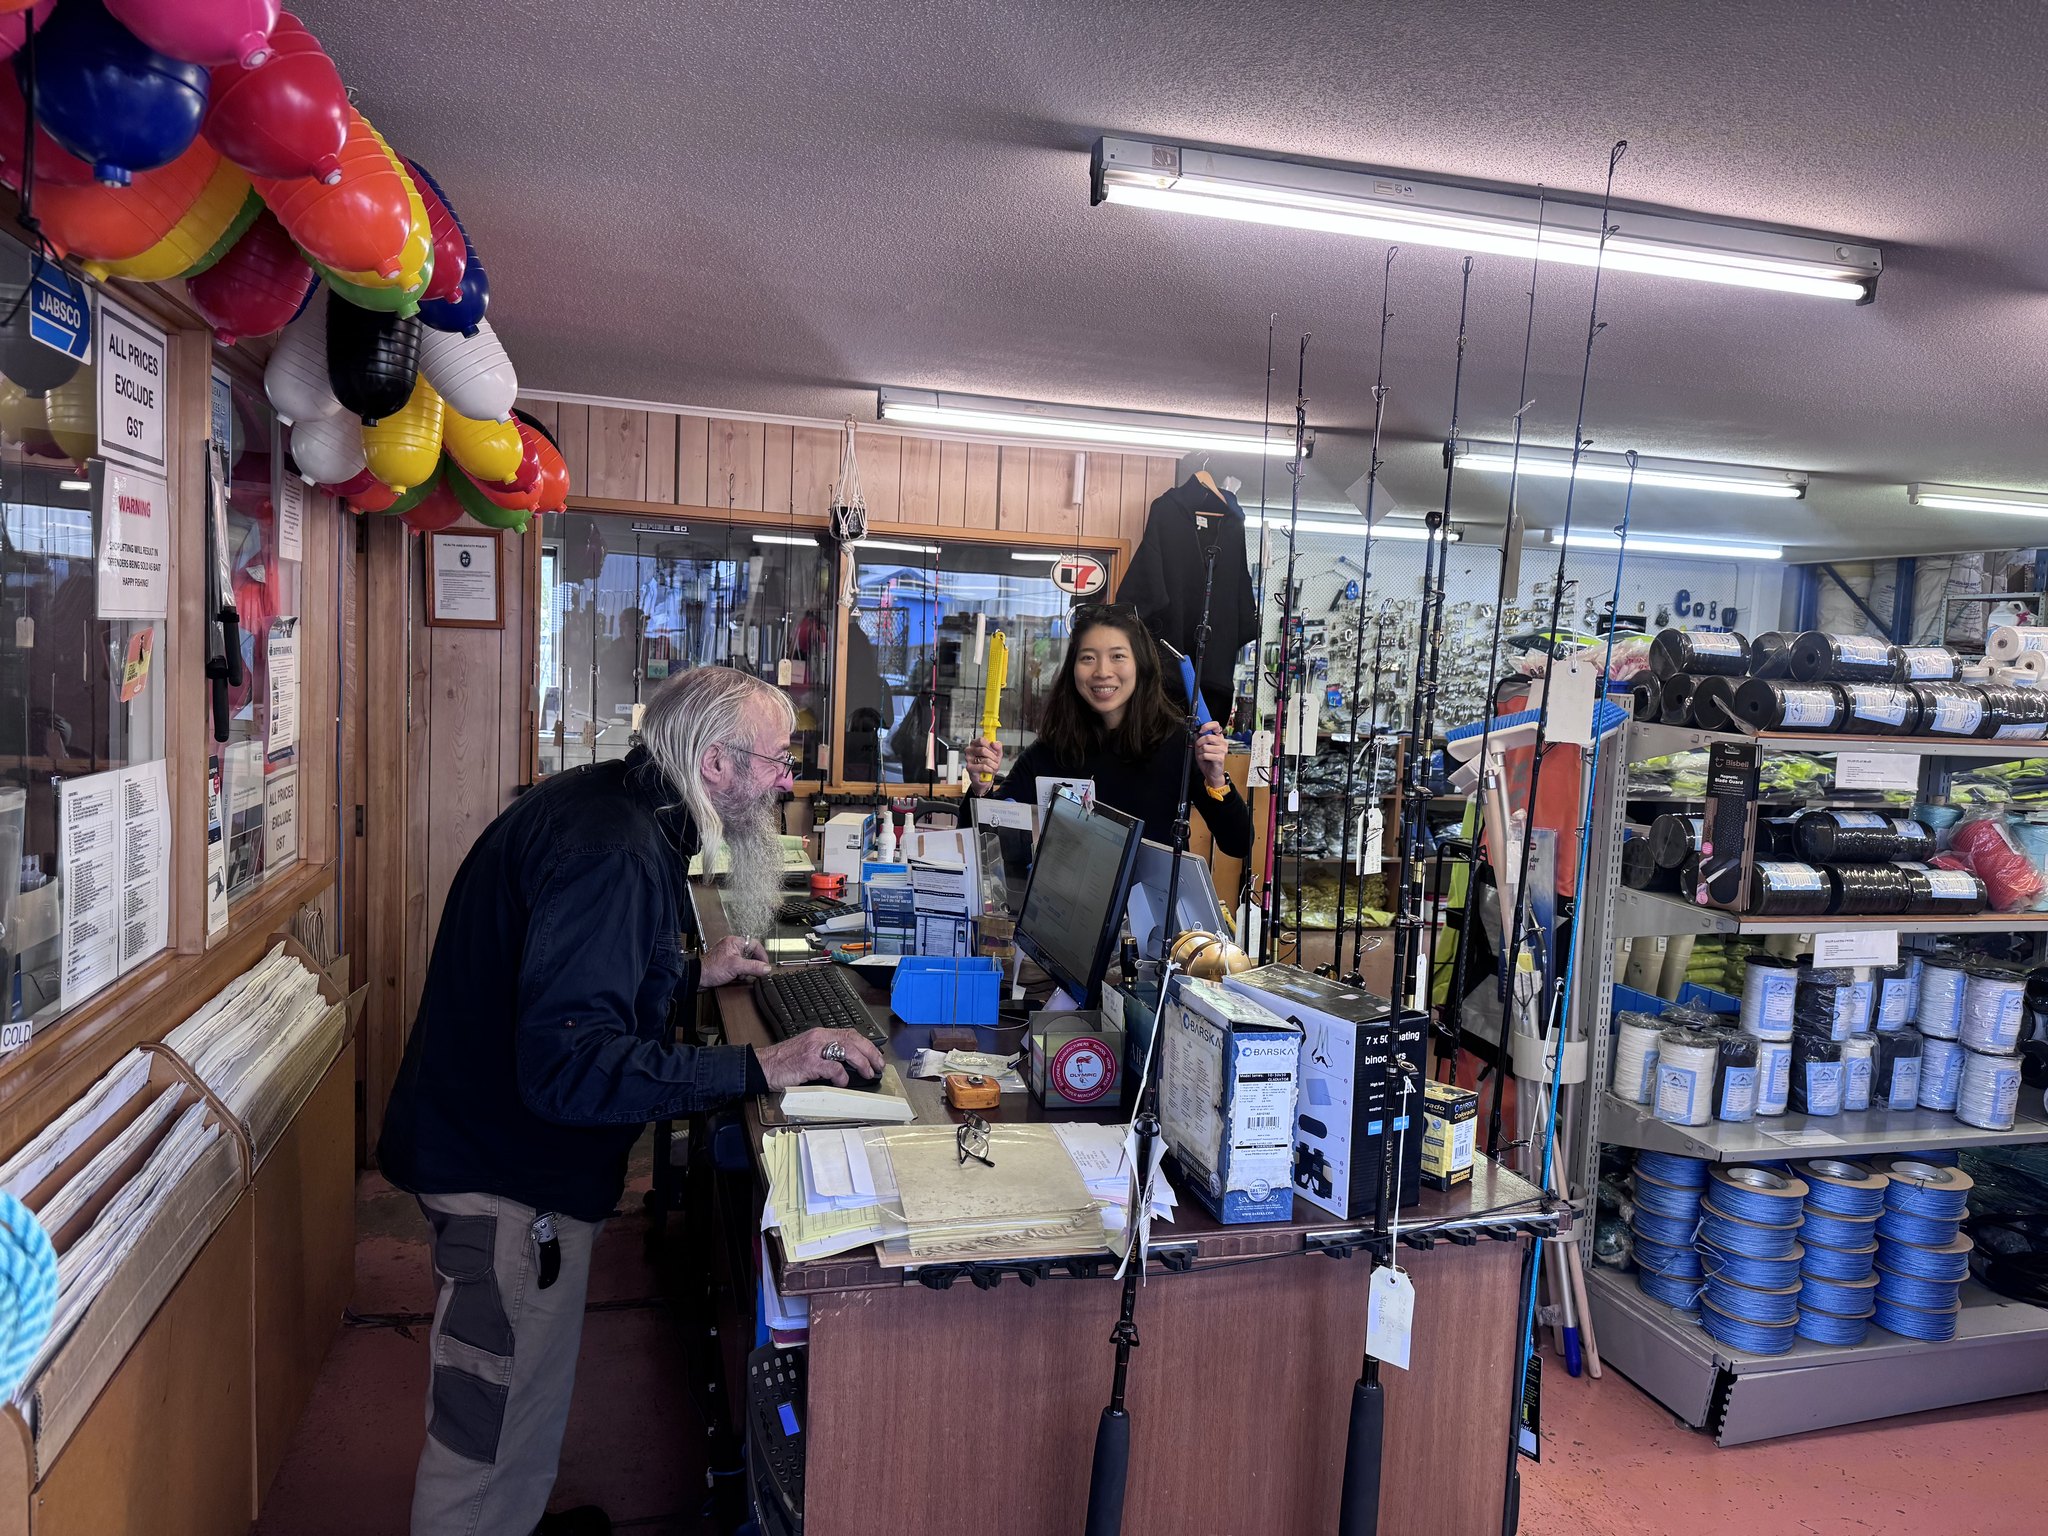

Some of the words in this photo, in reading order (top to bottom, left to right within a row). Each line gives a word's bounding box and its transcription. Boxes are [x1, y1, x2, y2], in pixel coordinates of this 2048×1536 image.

[39, 291, 81, 329] JABSCO
[109, 333, 127, 360] ALL
[128, 343, 159, 377] PRICES
[115, 373, 154, 409] EXCLUDE
[126, 416, 144, 440] GST
[118, 495, 151, 518] WARNING
[129, 560, 140, 569] BEING
[122, 577, 135, 587] HAPPY
[1725, 759, 1749, 767] Bisbell
[269, 789, 278, 808] ALL
[277, 784, 294, 801] PRICES
[271, 808, 292, 831] EXCLUDE
[275, 834, 286, 852] GST
[3, 1024, 31, 1047] COLD
[1190, 1020, 1222, 1050] BARSKA
[1366, 1036, 1371, 1046] 7
[1373, 1037, 1378, 1045] x
[1253, 1047, 1294, 1056] BARSKA
[1454, 1108, 1476, 1120] Colorado
